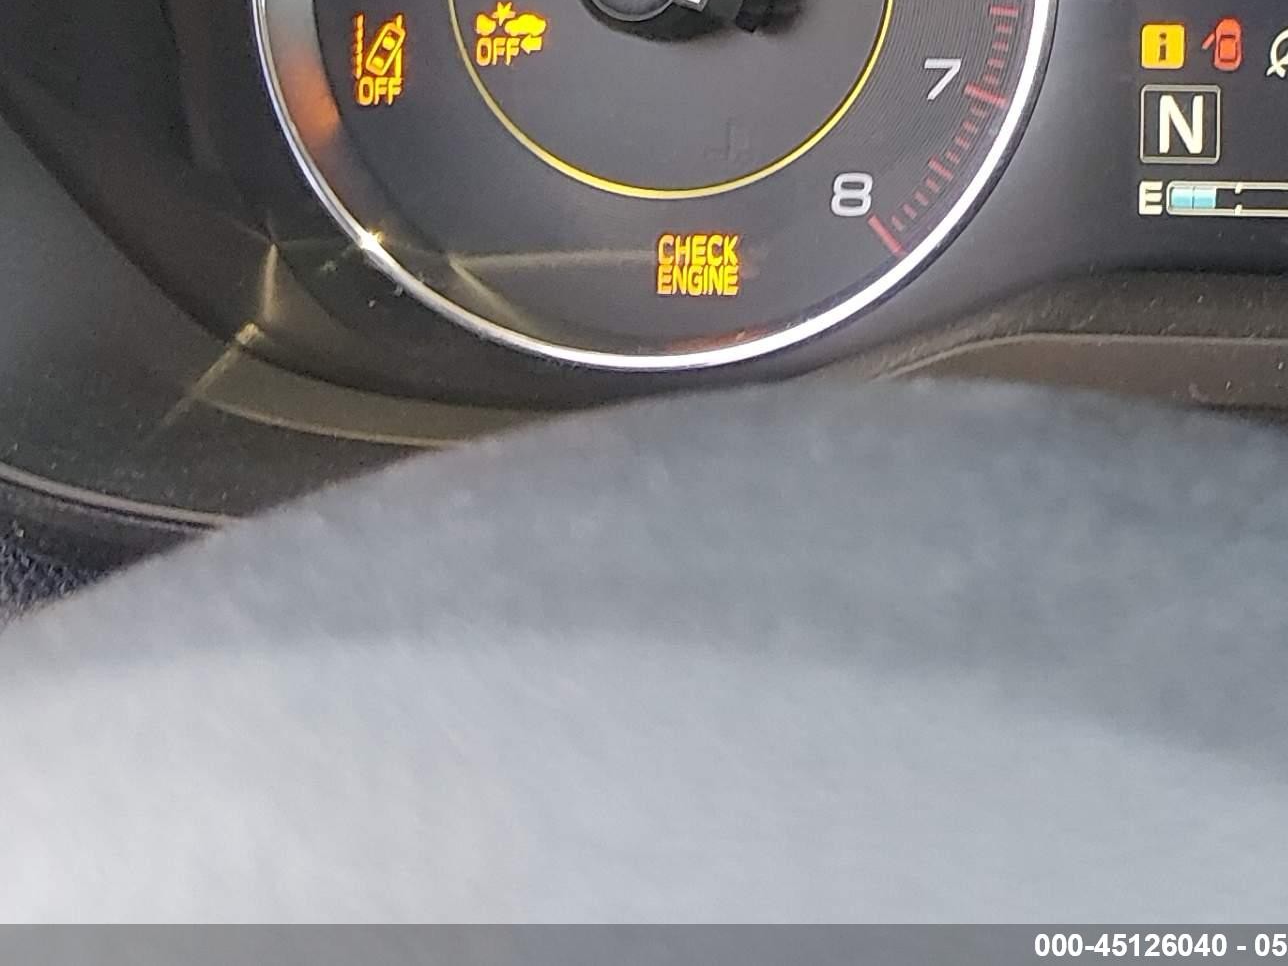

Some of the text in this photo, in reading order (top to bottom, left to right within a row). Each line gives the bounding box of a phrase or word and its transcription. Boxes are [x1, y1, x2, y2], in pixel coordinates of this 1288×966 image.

[477, 37, 518, 65] OFF
[356, 77, 403, 105] OFF
[924, 58, 962, 101] 7
[1159, 95, 1204, 154] N
[830, 173, 873, 216] 8
[1139, 181, 1162, 214] E
[658, 236, 739, 265] CHECK
[658, 267, 739, 296] ENGINE
